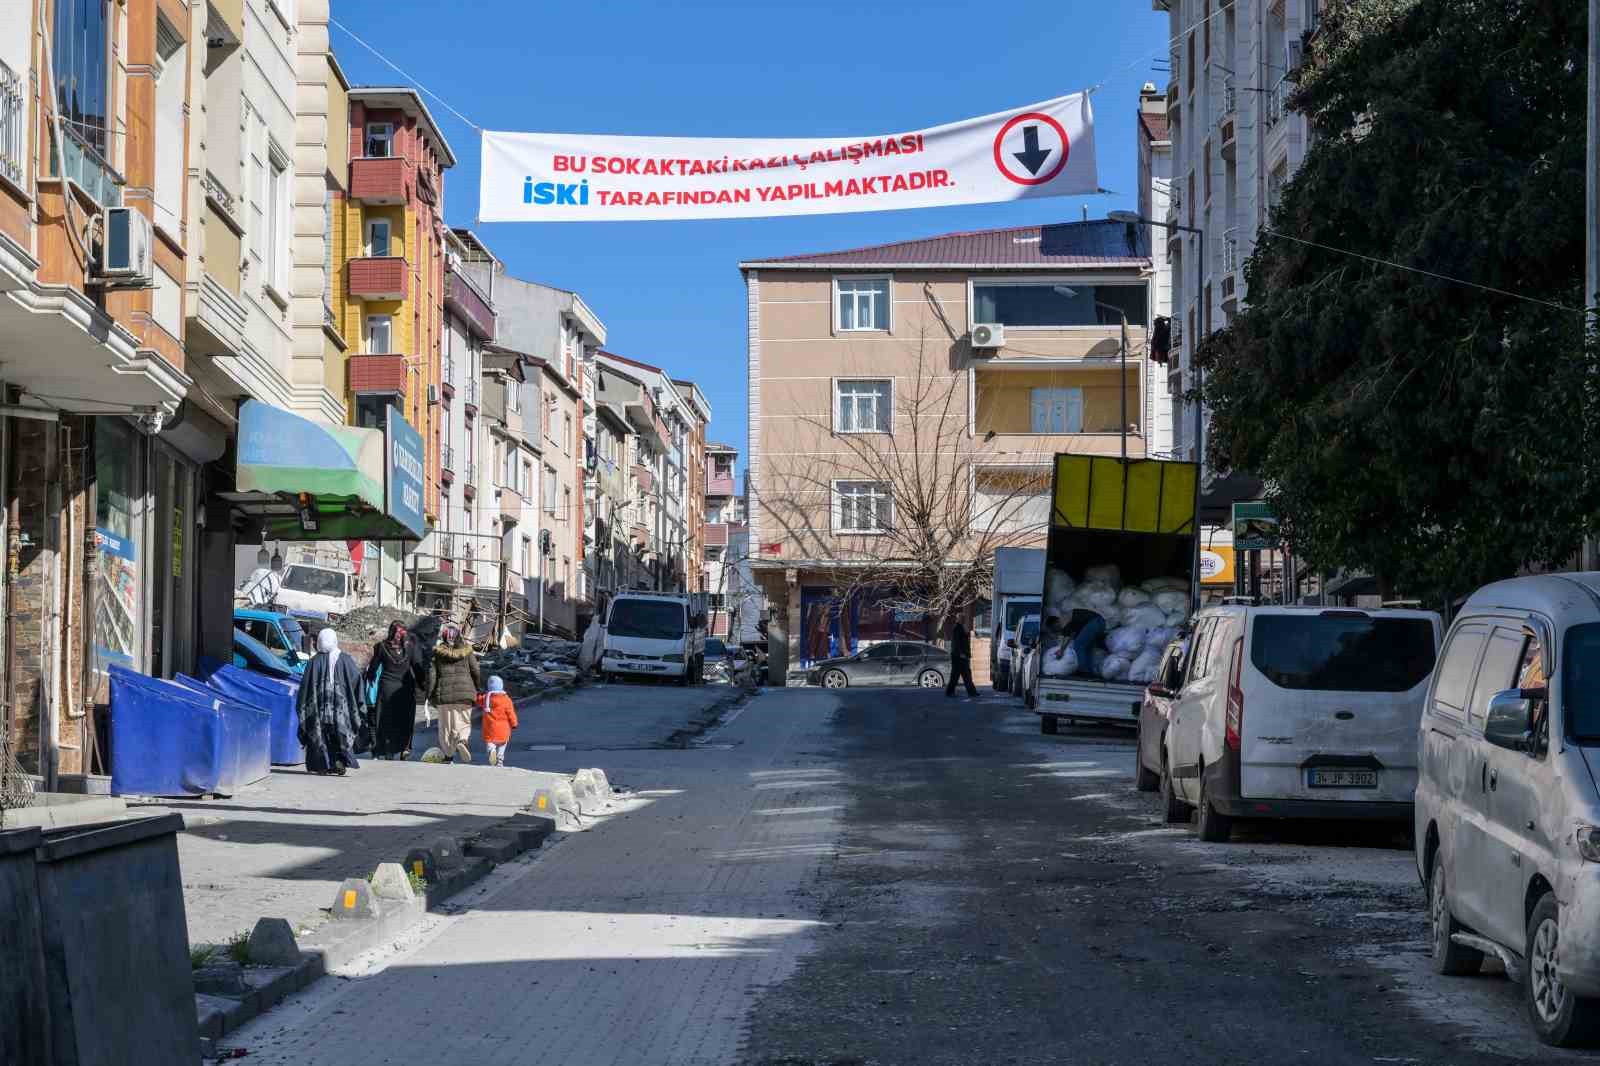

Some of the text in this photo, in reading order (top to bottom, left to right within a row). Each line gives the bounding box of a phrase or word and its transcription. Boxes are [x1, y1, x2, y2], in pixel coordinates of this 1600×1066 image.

[552, 155, 587, 173] BU
[591, 156, 728, 176] SOKAKTAKİ
[523, 169, 955, 206] İSKİ TARAFINDAN YAPILMAKTADIR.
